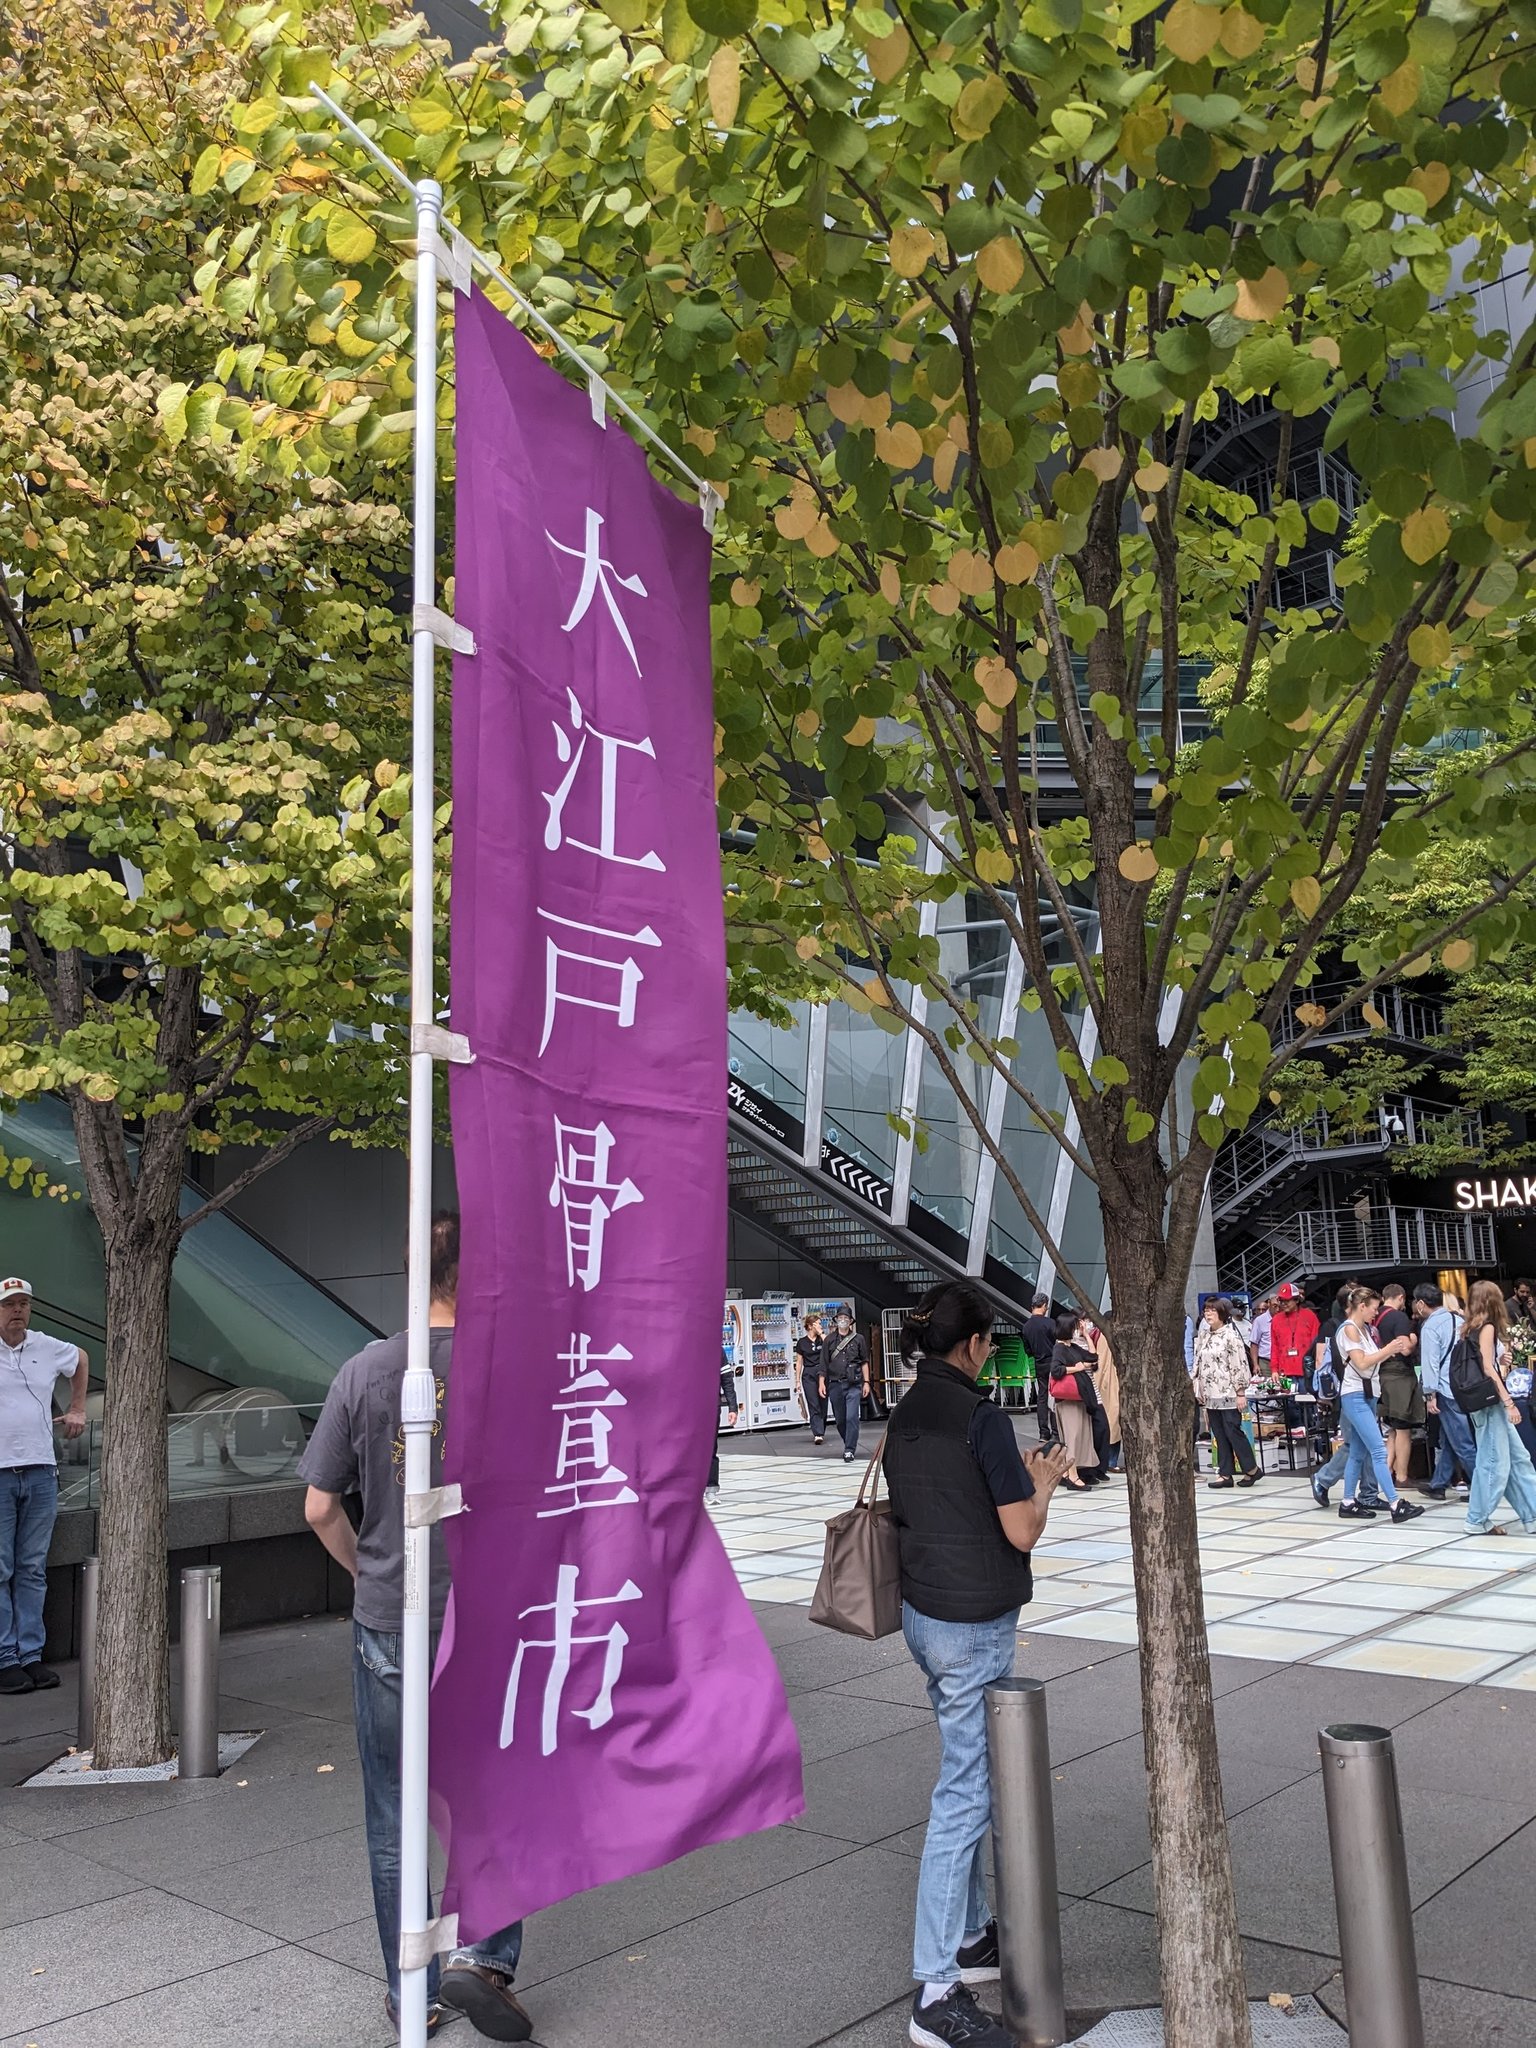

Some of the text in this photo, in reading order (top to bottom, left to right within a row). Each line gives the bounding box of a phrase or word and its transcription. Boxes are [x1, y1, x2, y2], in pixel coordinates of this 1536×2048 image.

[499, 506, 667, 1757] 大江戸骨董市
[1456, 1177, 1536, 1209] SHAK
[1496, 1207, 1527, 1217] FRIES
